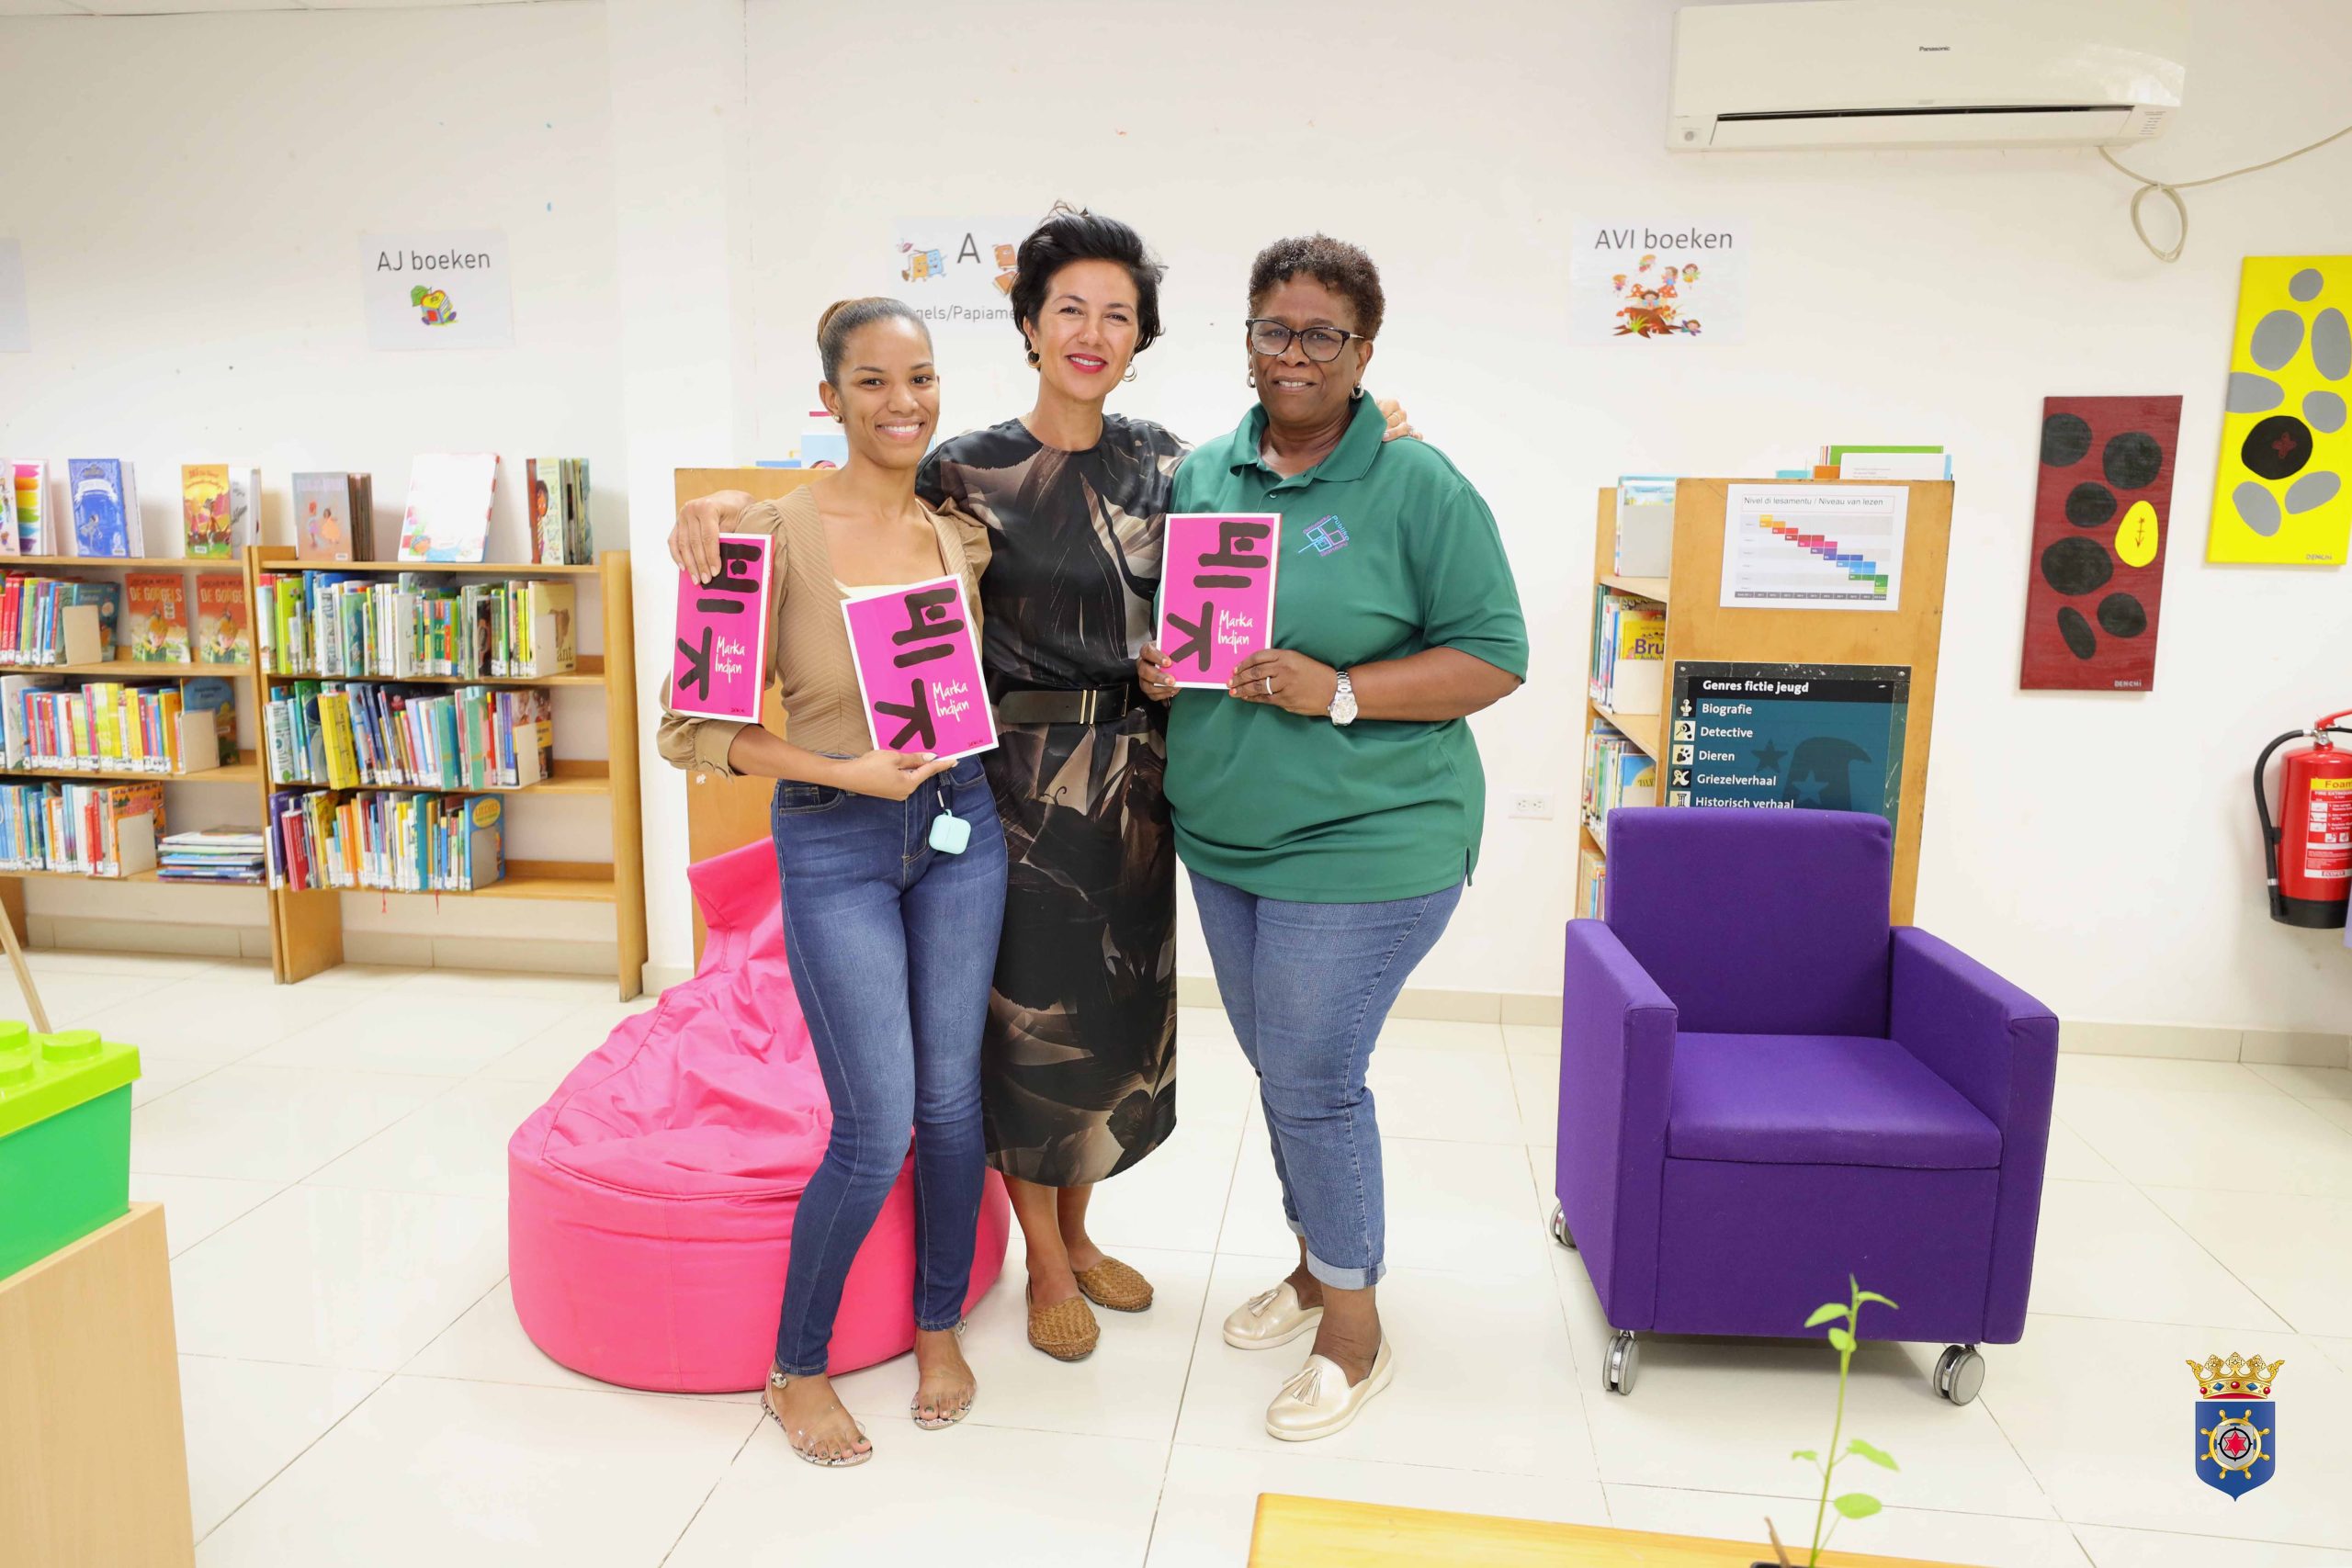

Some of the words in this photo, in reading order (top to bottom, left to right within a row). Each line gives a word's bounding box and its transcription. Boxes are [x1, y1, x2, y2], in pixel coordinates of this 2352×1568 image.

[1595, 229, 1635, 249] AVI
[1645, 227, 1733, 249] boeken
[956, 232, 981, 264] A
[378, 250, 403, 272] AJ
[411, 249, 491, 271] boeken
[1774, 497, 1812, 505] lesamentu
[1818, 497, 1845, 505] Niveau
[1863, 498, 1883, 506] lezen
[1218, 609, 1253, 630] Marka
[716, 636, 745, 658] Marka
[933, 680, 968, 702] Marka
[1702, 680, 1743, 692] Genres
[1744, 680, 1774, 693] fictie
[1775, 681, 1810, 695] jeugd
[1702, 703, 1753, 716] Biografie
[1700, 727, 1754, 739] Detective
[1699, 750, 1736, 761] Dieren
[1696, 773, 1778, 786] Griezelverhaal
[1695, 796, 1750, 807] Historisch
[1753, 798, 1794, 808] verhaal
